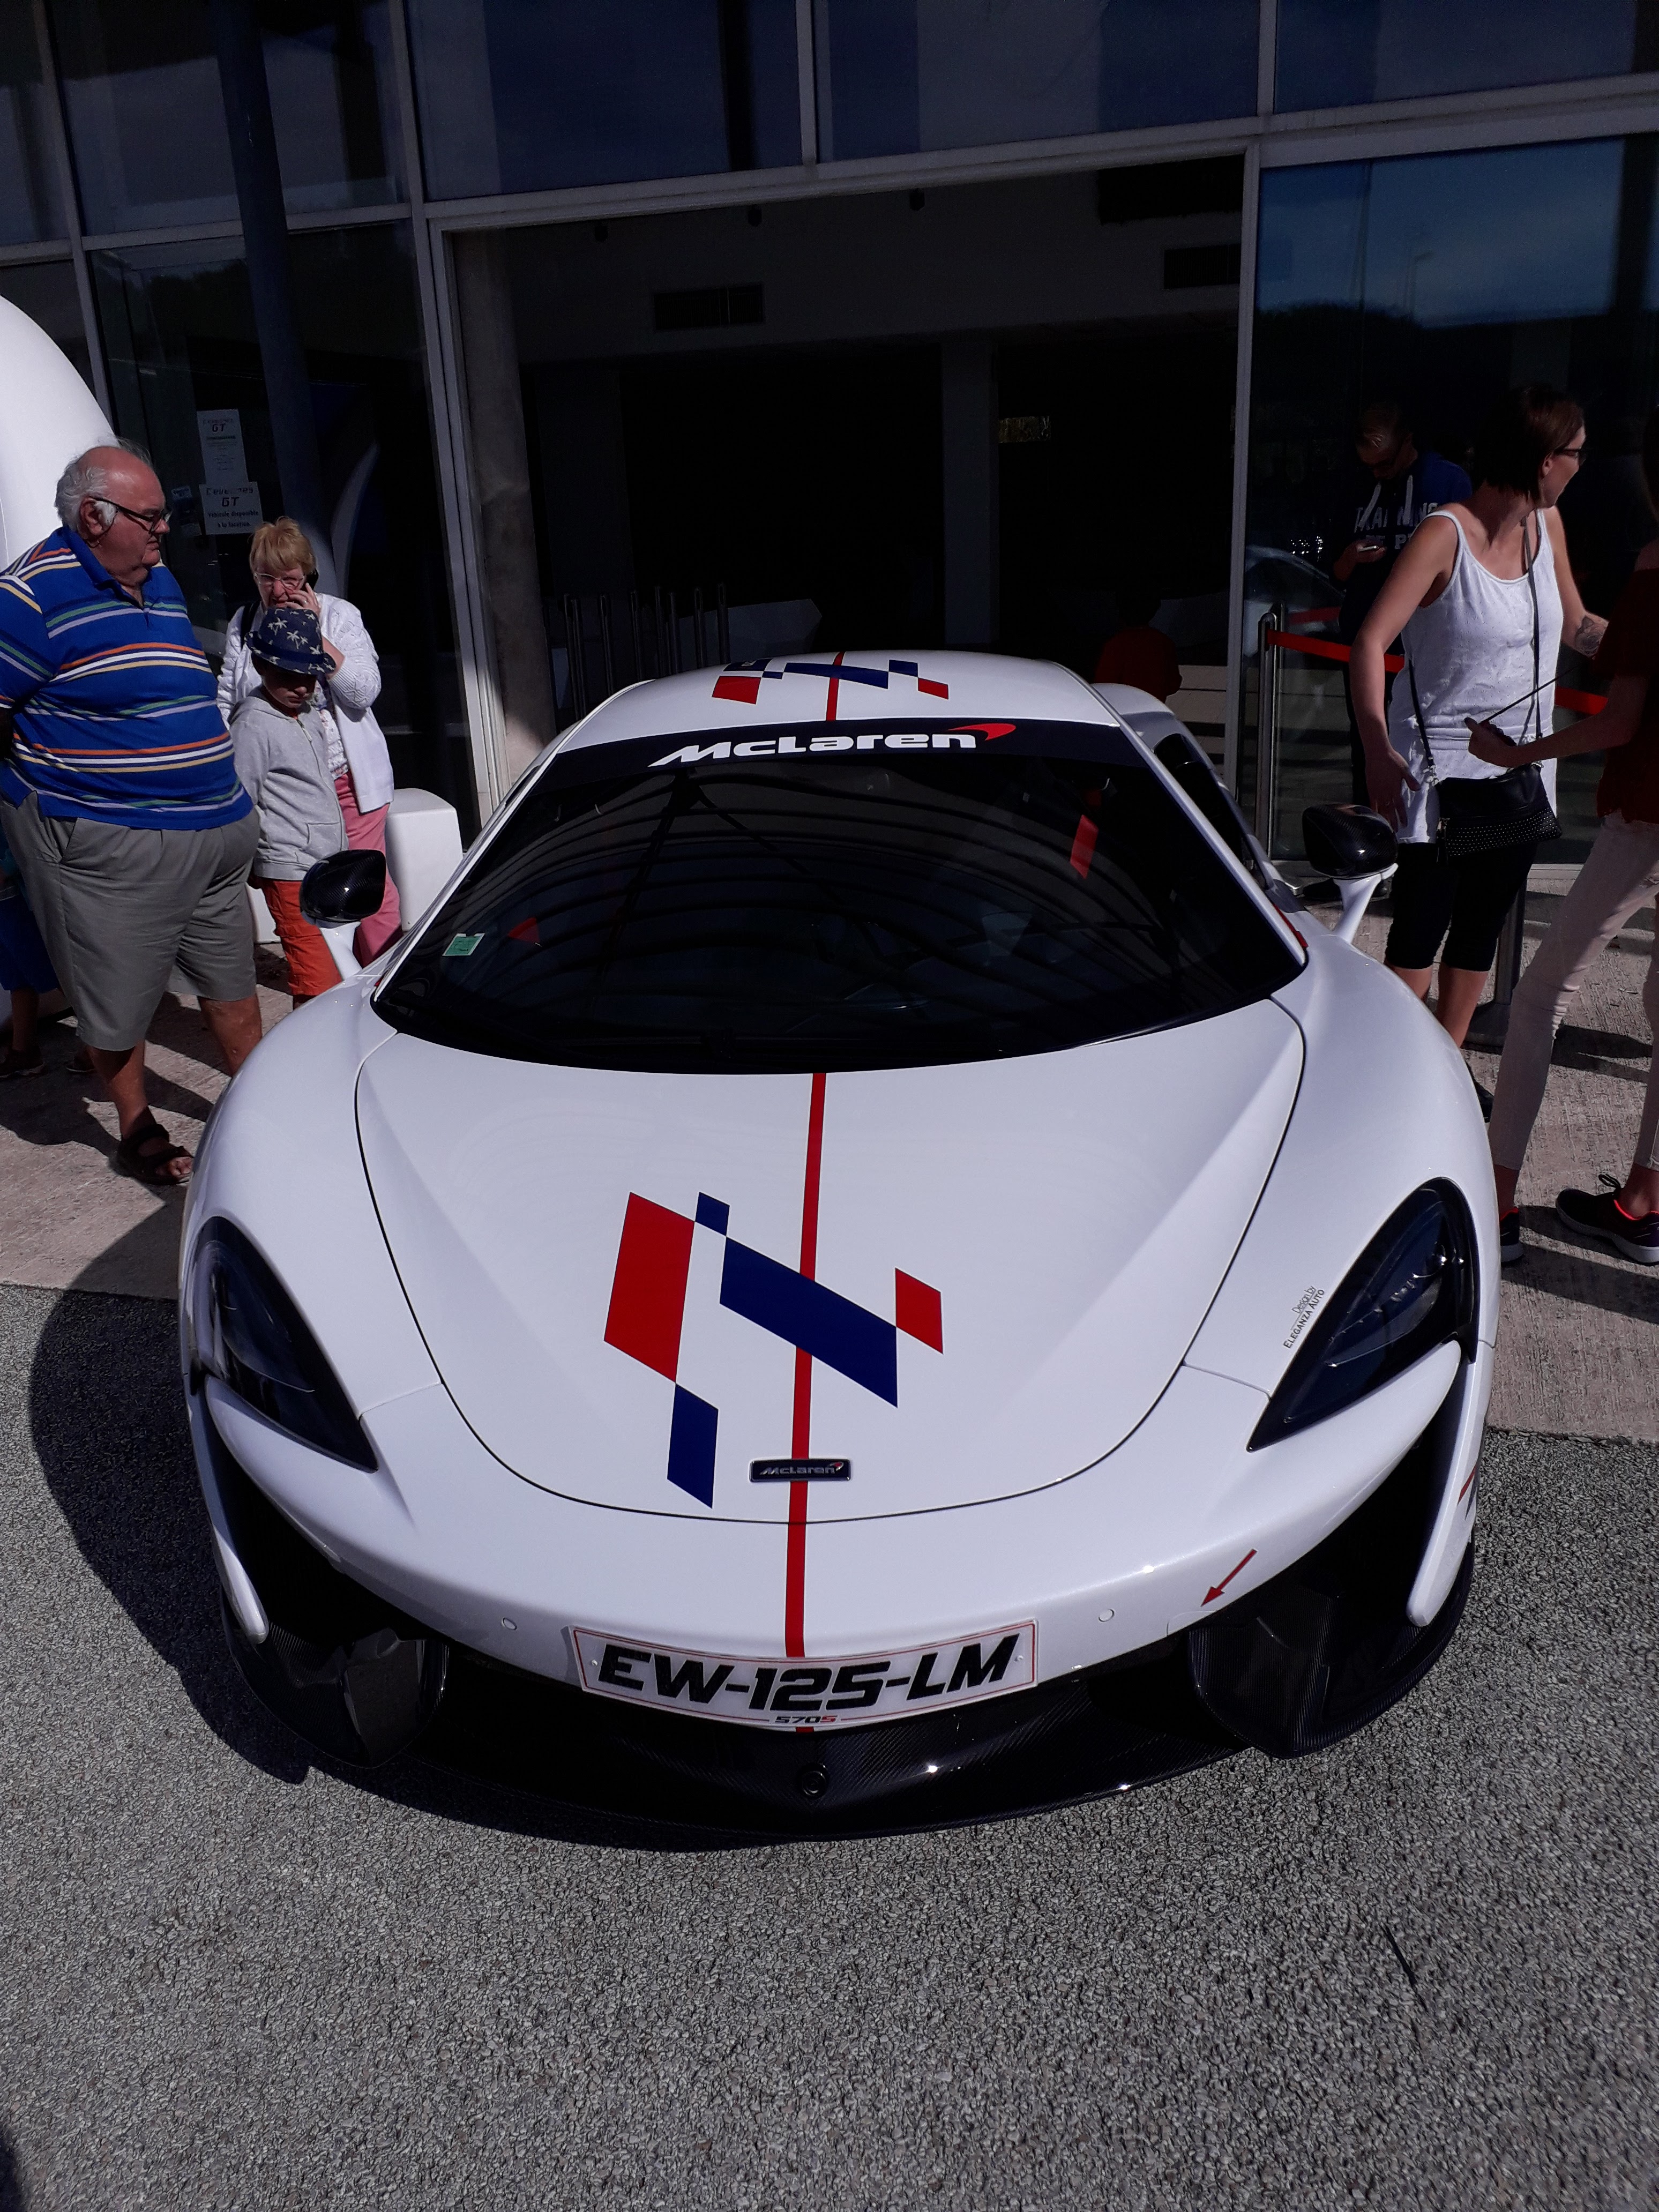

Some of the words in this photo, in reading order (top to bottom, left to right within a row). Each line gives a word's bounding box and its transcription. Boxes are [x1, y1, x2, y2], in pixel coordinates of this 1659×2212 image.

[212, 423, 226, 432] GT
[222, 497, 240, 507] GT
[647, 733, 976, 767] McLaren
[1291, 1293, 1310, 1314] Design
[1304, 1285, 1317, 1295] by
[1283, 1310, 1313, 1349] ELEGANZA
[1308, 1289, 1325, 1310] AUTO
[759, 1466, 835, 1475] McLaren
[597, 1633, 1020, 1712] EW-125-LM
[774, 1715, 838, 1723] 570S
